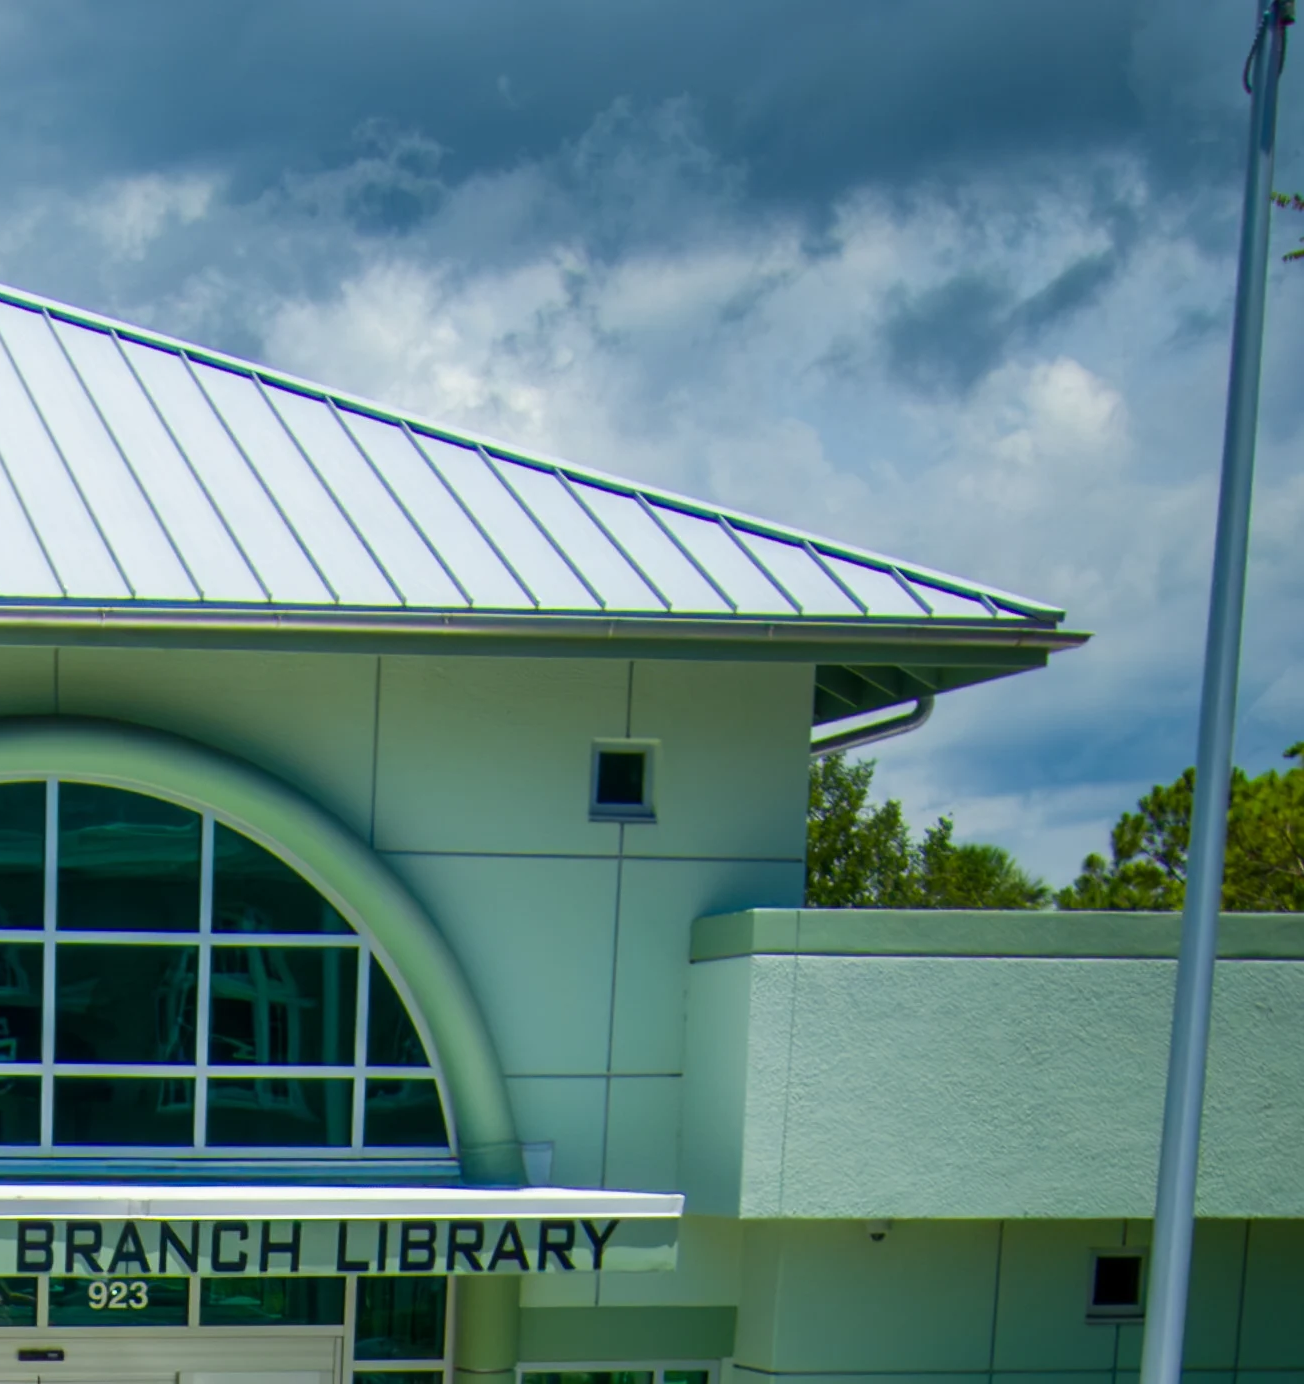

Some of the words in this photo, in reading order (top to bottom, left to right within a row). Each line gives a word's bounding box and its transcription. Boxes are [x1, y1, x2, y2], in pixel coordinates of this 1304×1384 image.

[16, 1219, 302, 1275] BRANCH
[336, 1219, 620, 1273] LIBRARY
[88, 1281, 149, 1310] 923
